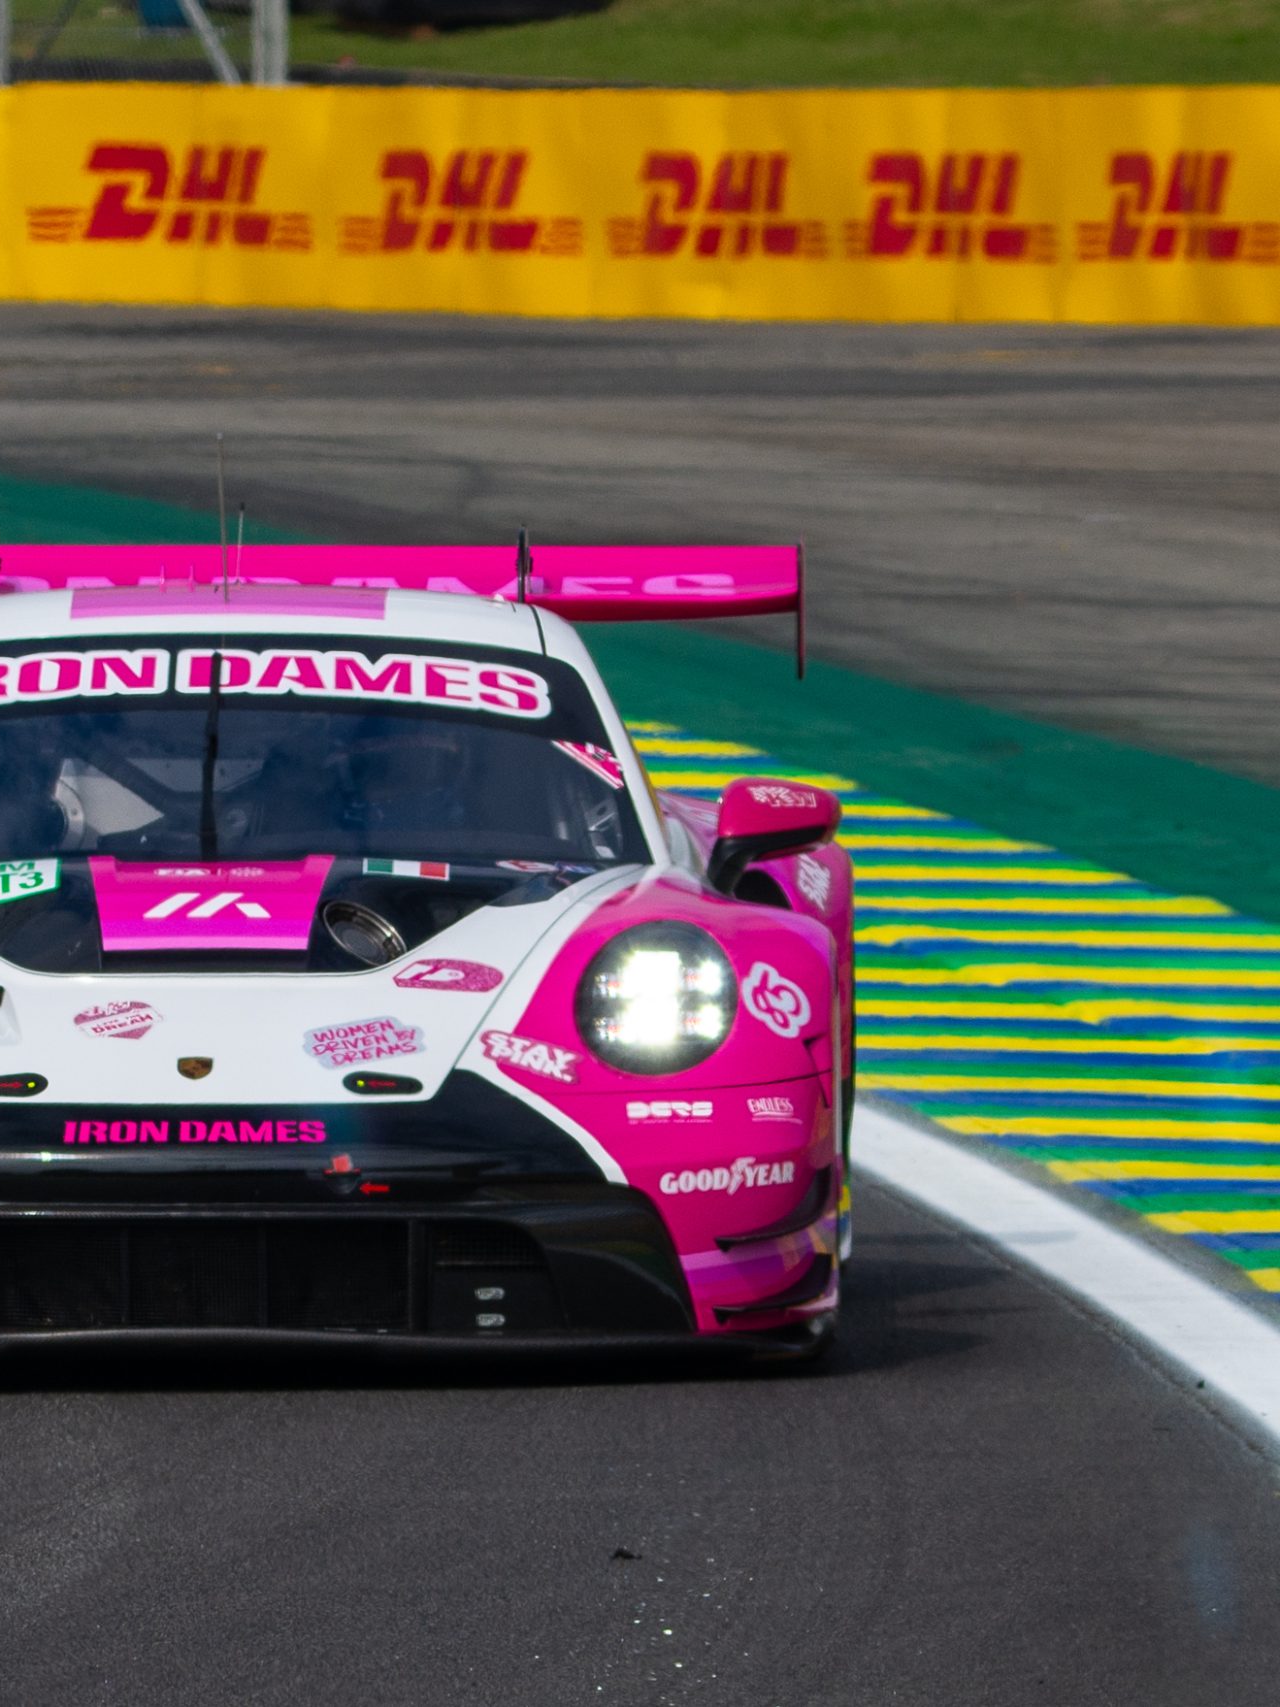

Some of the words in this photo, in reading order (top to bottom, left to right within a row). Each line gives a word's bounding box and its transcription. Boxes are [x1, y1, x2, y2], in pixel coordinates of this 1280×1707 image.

[84, 144, 271, 245] DHL
[381, 151, 538, 253] DHL
[640, 152, 797, 257] DHL
[868, 153, 1025, 260] DHL
[181, 651, 547, 715] DAMES
[312, 1034, 389, 1056] DRIVEN
[313, 1018, 395, 1042] WOMEN
[331, 1040, 417, 1066] DREAMS
[487, 1033, 576, 1070] STAY
[63, 1120, 169, 1144] IRON
[178, 1120, 327, 1144] DAMES
[659, 1156, 796, 1196] GOODYEAR
